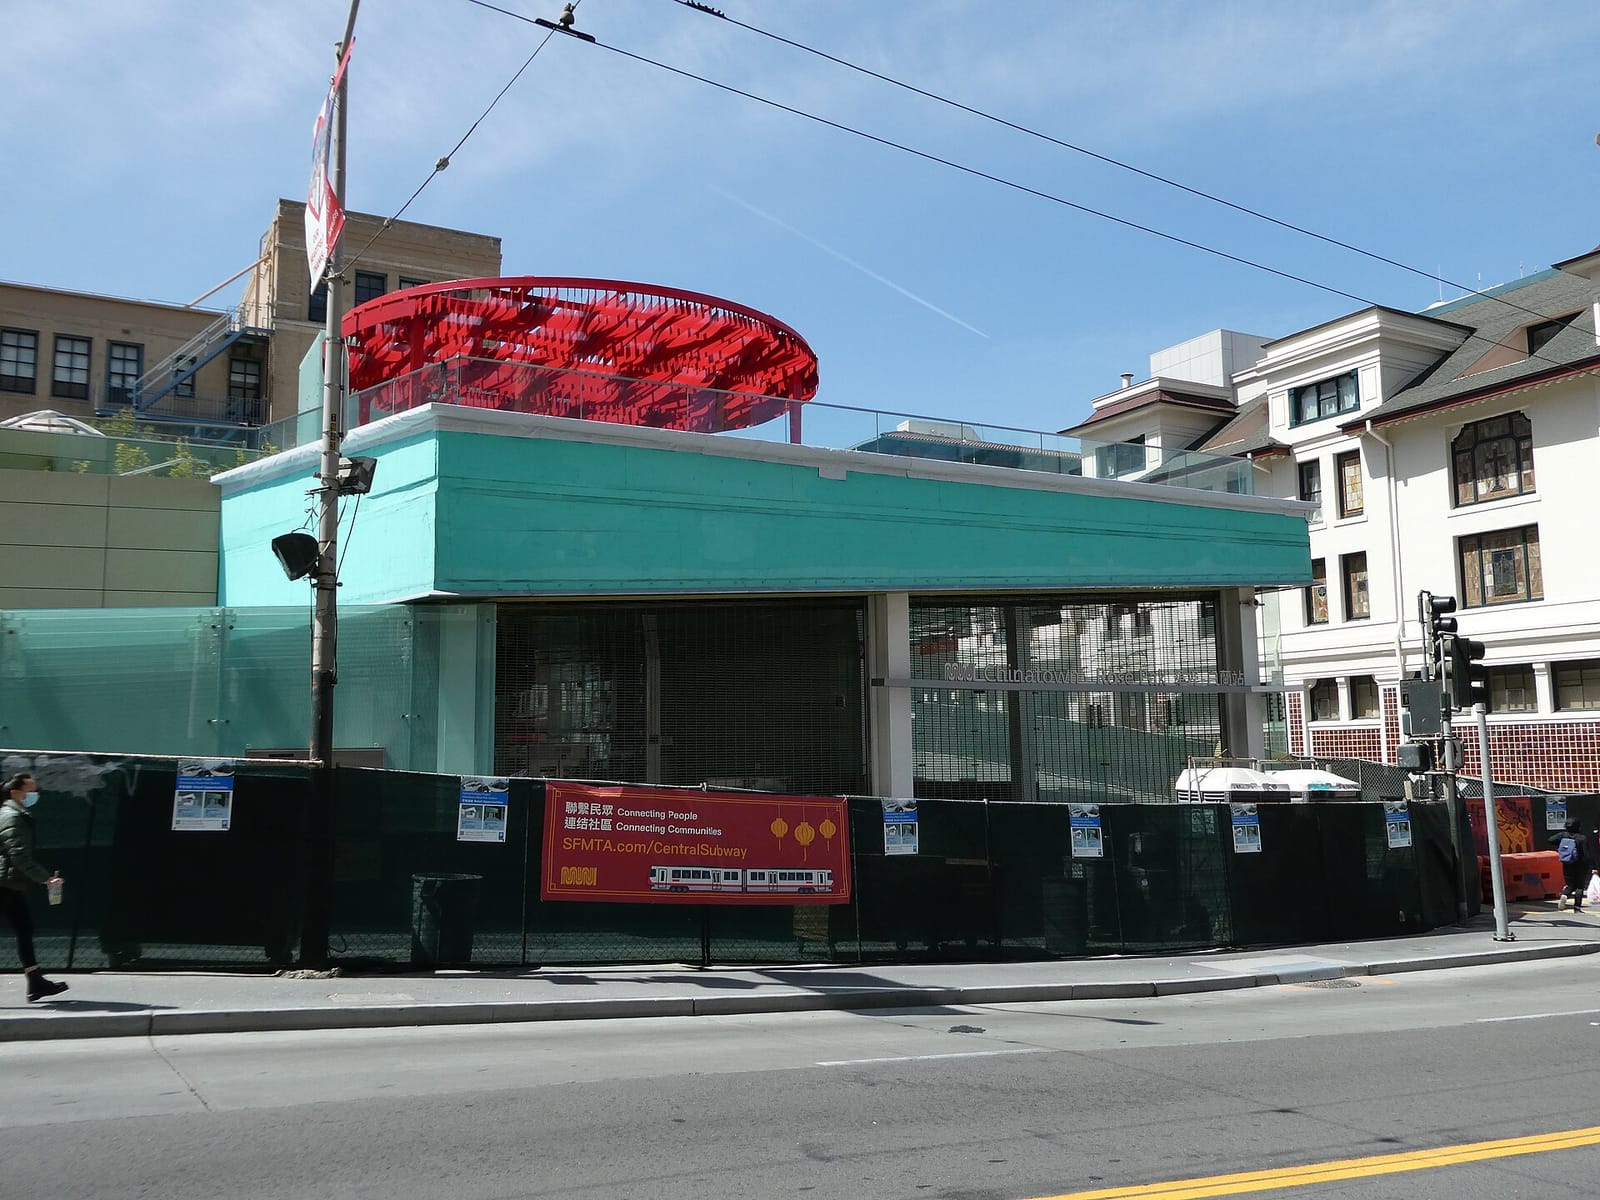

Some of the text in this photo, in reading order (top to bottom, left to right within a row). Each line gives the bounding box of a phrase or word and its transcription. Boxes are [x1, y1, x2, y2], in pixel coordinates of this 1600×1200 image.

[984, 663, 1080, 684] Chinatown
[617, 808, 698, 821] Connecting People
[616, 822, 722, 836] Connecting Communities
[562, 837, 747, 860] SFMTA.com/CentralSubway
